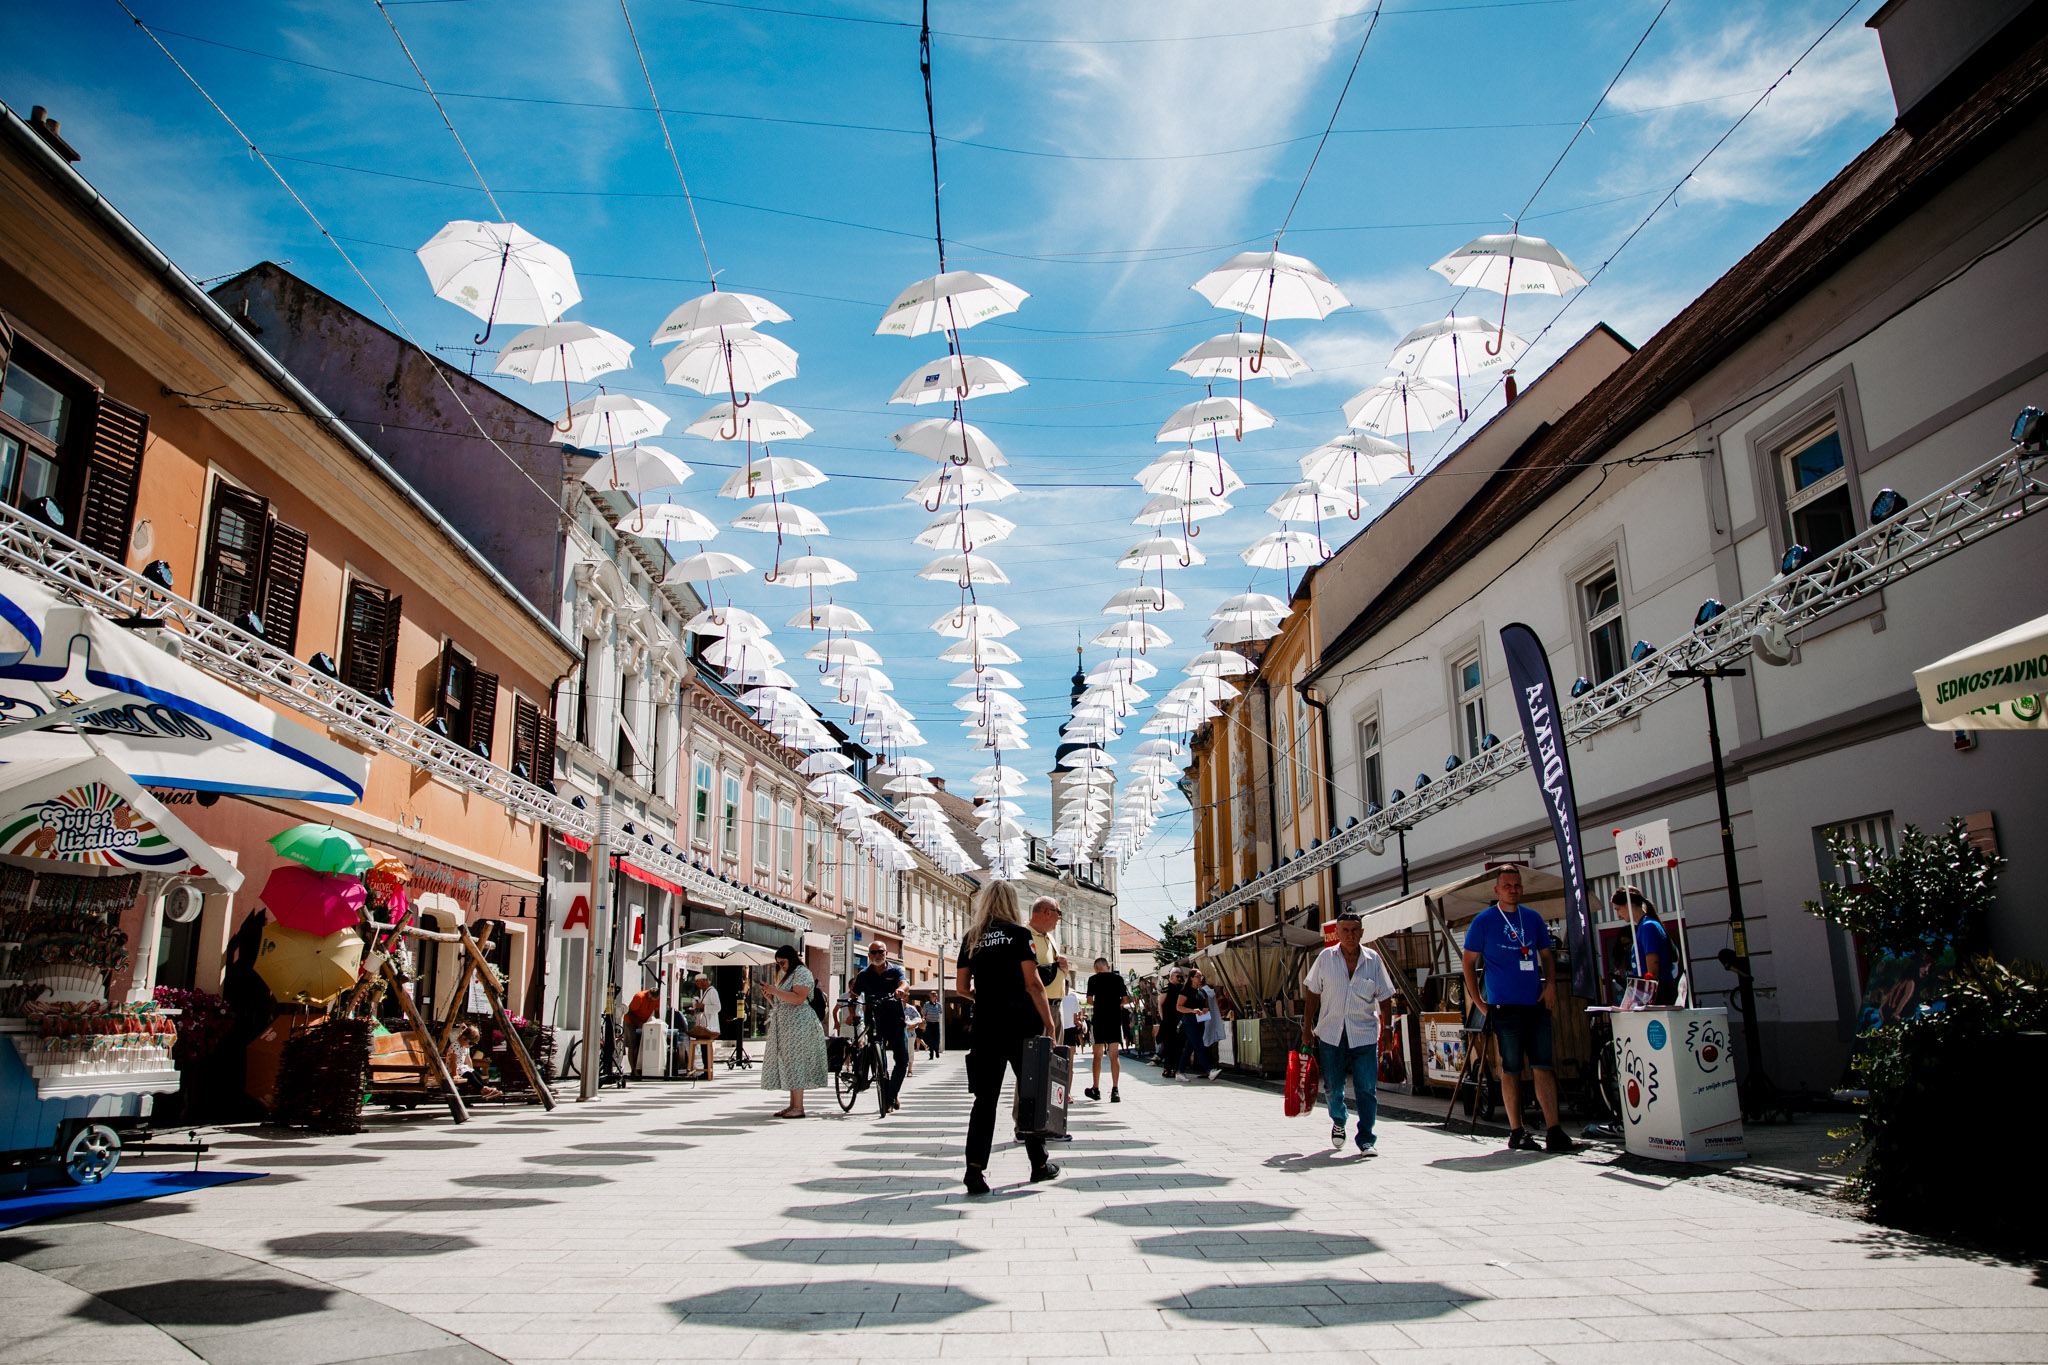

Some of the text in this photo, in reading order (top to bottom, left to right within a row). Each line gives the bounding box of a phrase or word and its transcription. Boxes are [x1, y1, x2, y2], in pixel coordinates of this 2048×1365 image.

[898, 299, 918, 309] PAN
[666, 324, 684, 332] PAN
[1936, 654, 2048, 705] JEDNOSTAVNO
[40, 808, 112, 834] Svijet
[60, 829, 139, 852] lizalica
[1625, 852, 1642, 865] CRVENI
[562, 895, 590, 930] A
[982, 931, 1005, 940] OKOL
[974, 938, 1013, 949] ECURITY
[1649, 1136, 1663, 1145] CRVENI
